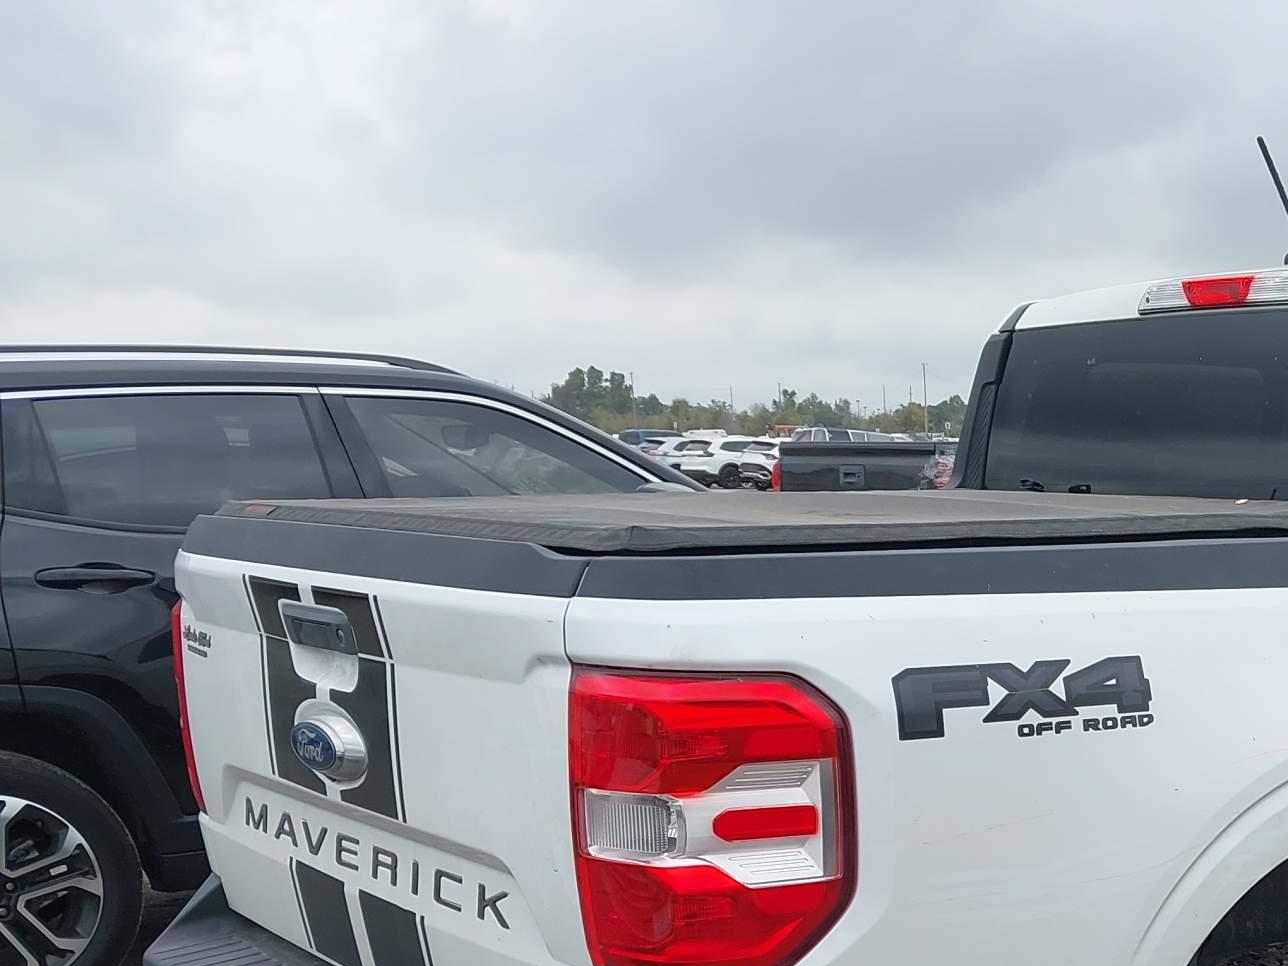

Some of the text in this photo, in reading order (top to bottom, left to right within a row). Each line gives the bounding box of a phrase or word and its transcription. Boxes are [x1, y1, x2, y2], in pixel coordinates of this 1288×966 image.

[891, 654, 1153, 741] FX4
[1017, 713, 1154, 738] OFF ROAD
[297, 728, 325, 762] Ford
[244, 796, 511, 931] MAVERICK
